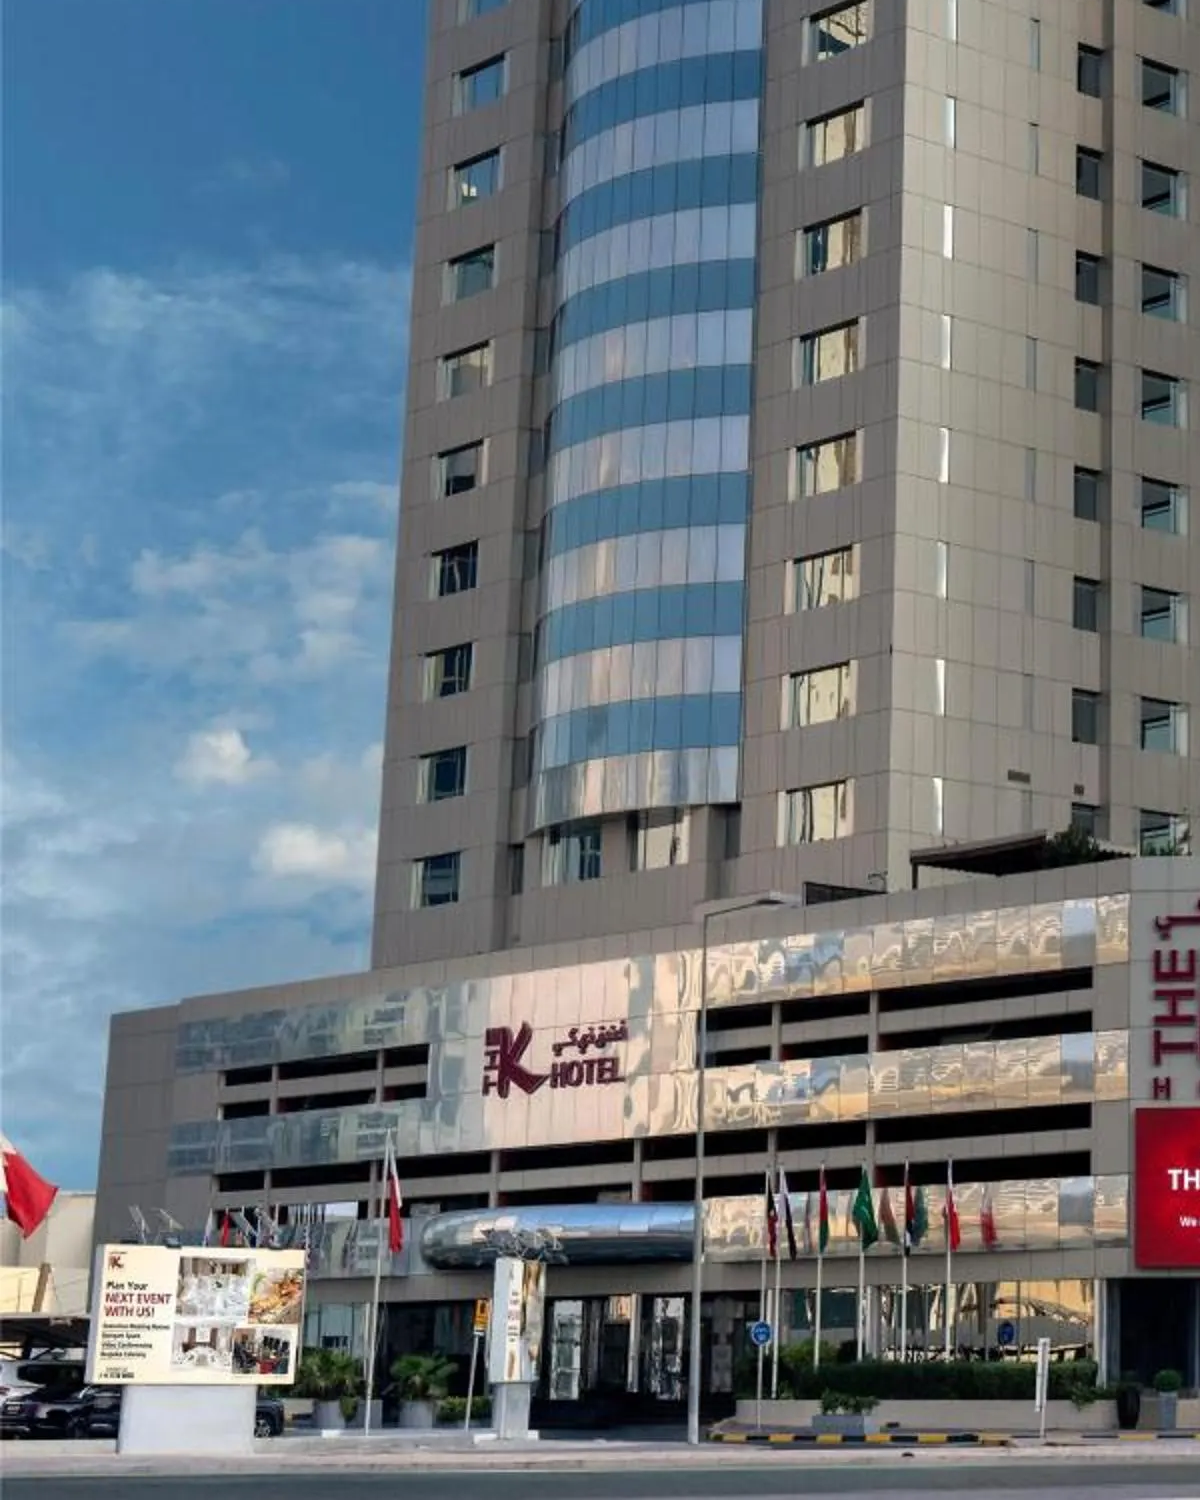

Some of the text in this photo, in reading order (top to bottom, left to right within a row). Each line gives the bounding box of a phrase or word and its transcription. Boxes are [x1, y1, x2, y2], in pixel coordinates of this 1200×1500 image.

[1153, 949, 1197, 1067] THE
[482, 1020, 551, 1099] THE K
[550, 1057, 626, 1089] HOTEL
[1179, 1215, 1198, 1228] We
[106, 1281, 149, 1290] Plan Your
[105, 1293, 173, 1304] NEXT EVENT
[104, 1305, 156, 1318] WITH US!
